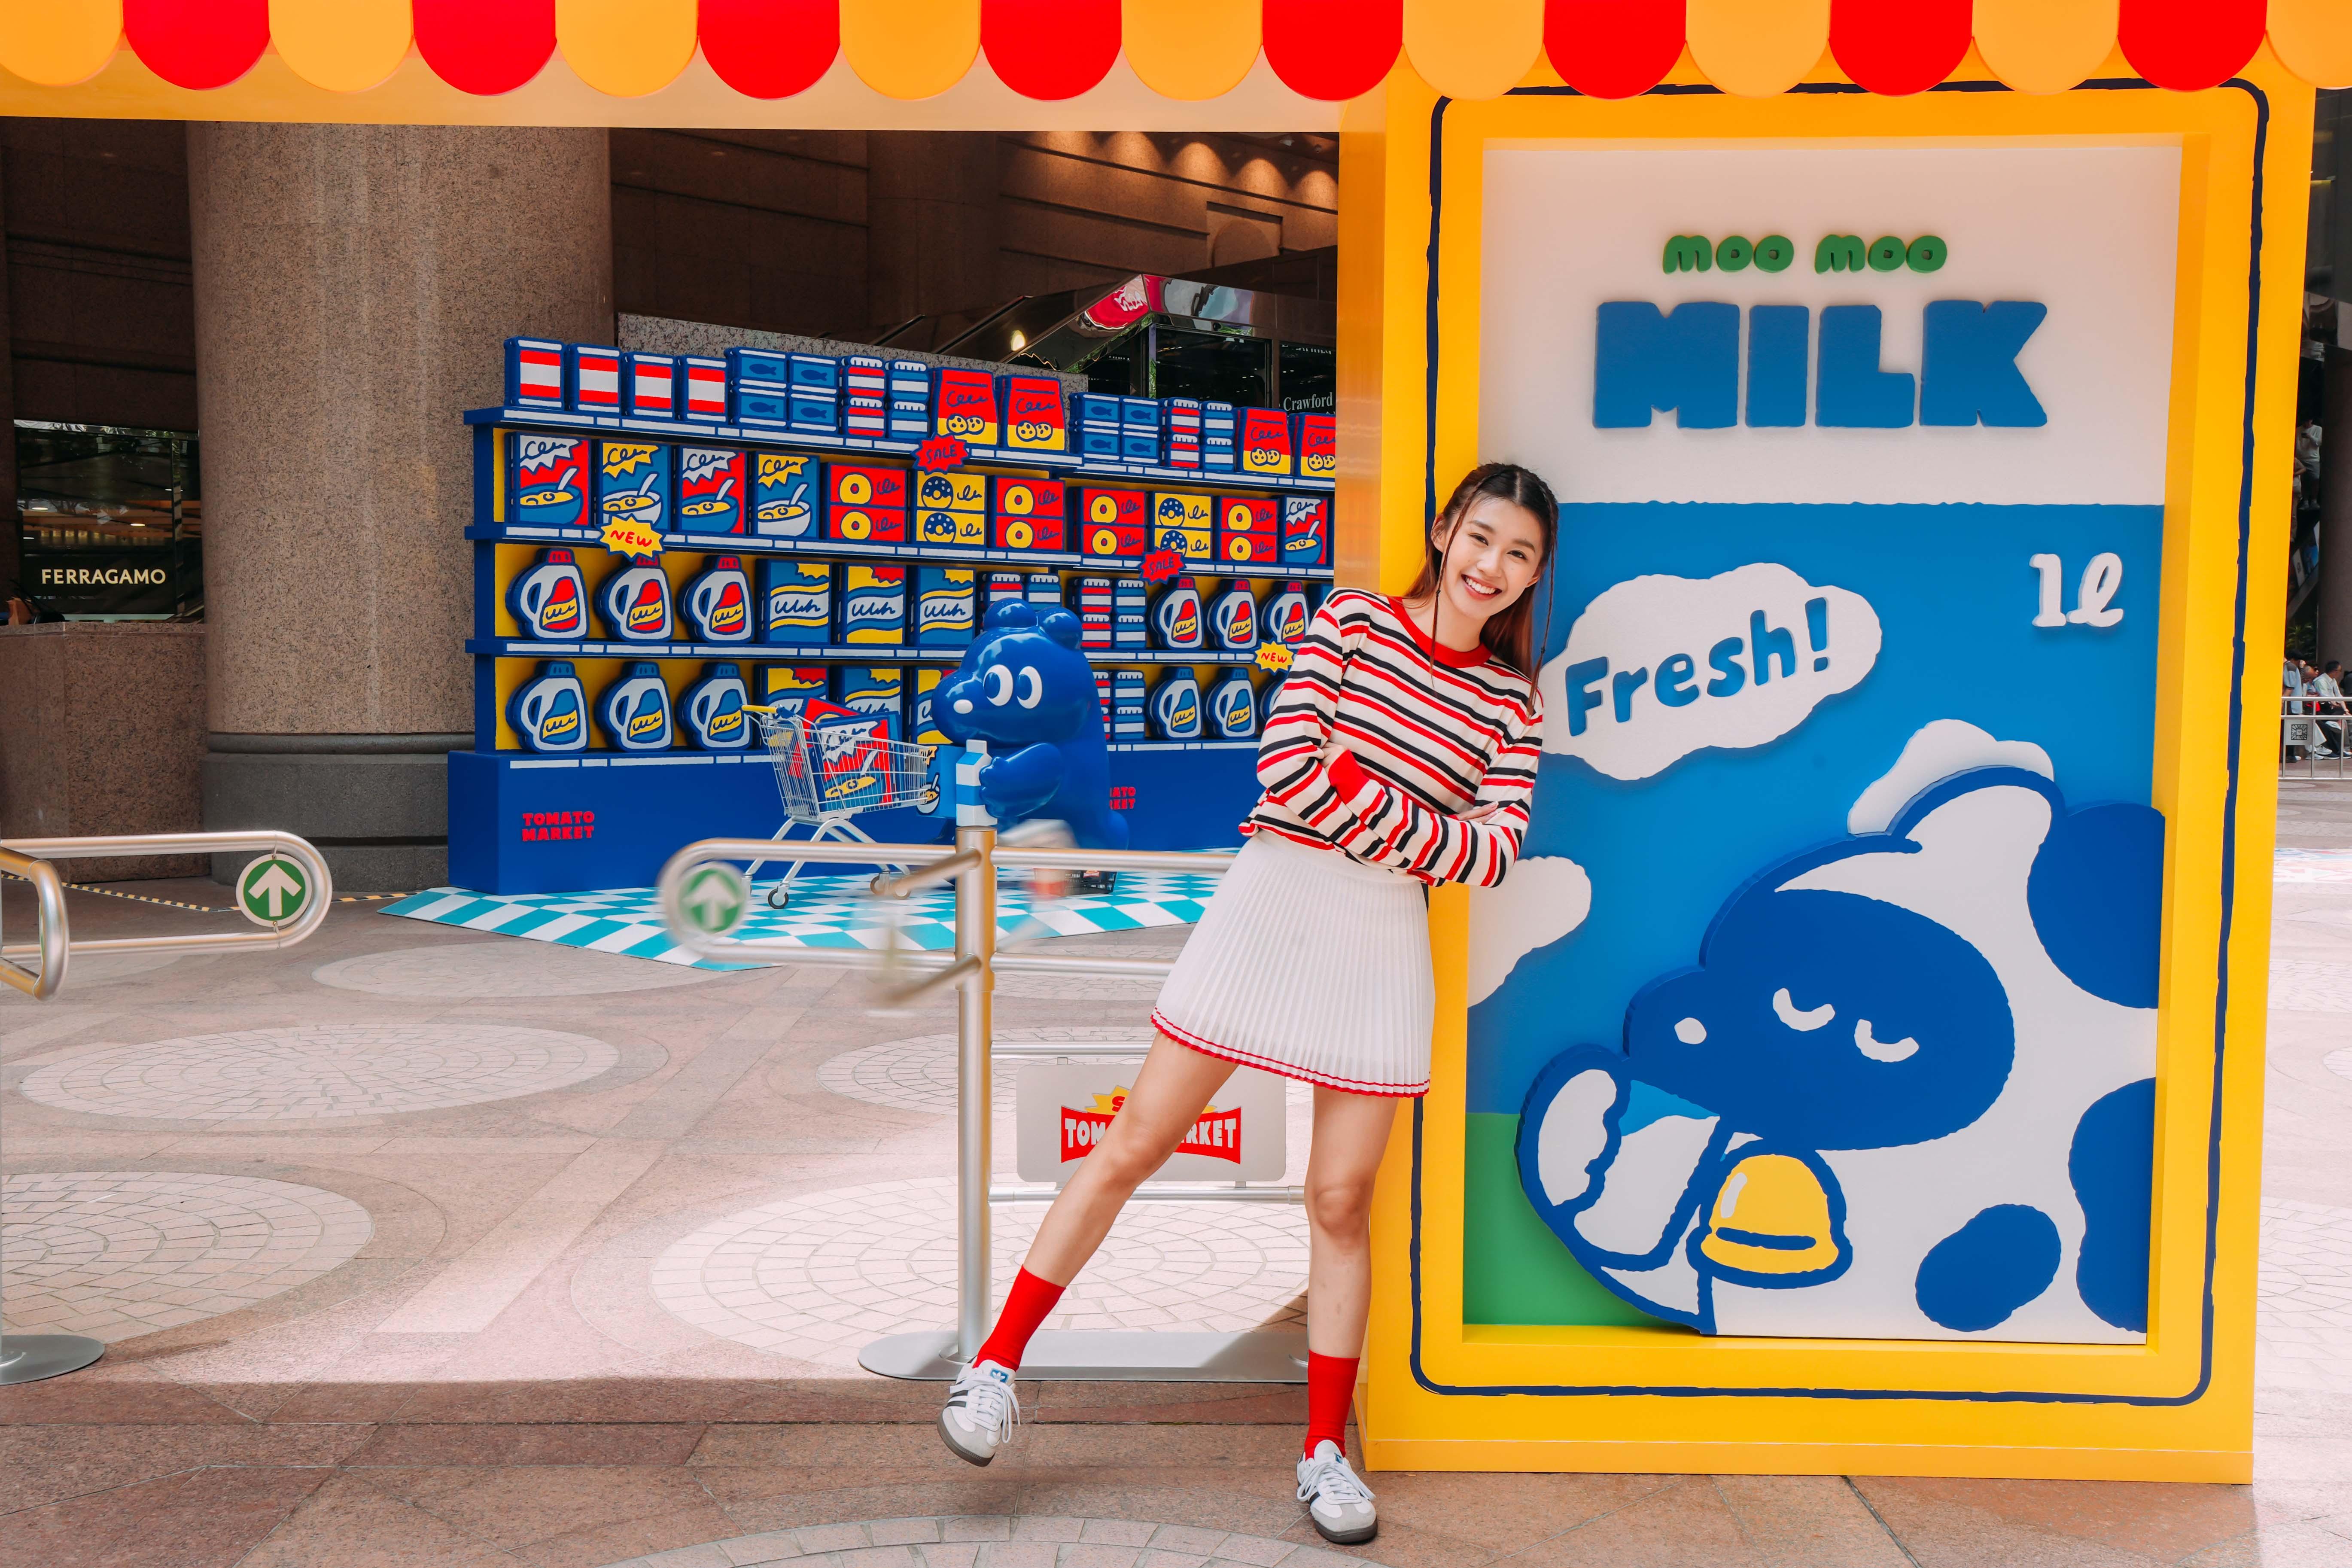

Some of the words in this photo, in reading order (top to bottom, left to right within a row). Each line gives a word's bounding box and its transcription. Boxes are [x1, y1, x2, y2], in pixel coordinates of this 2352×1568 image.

[1592, 299, 2048, 429] MILK
[1283, 392, 1333, 411] Crawford
[926, 444, 957, 464] SALE
[610, 530, 652, 547] NEW
[1149, 556, 1174, 575] SALE
[41, 569, 166, 584] FERRAGAMO
[1261, 652, 1287, 663] NEW
[1565, 597, 1829, 737] Fresh!
[522, 811, 594, 826] TOMATO
[522, 825, 594, 841] MARKET
